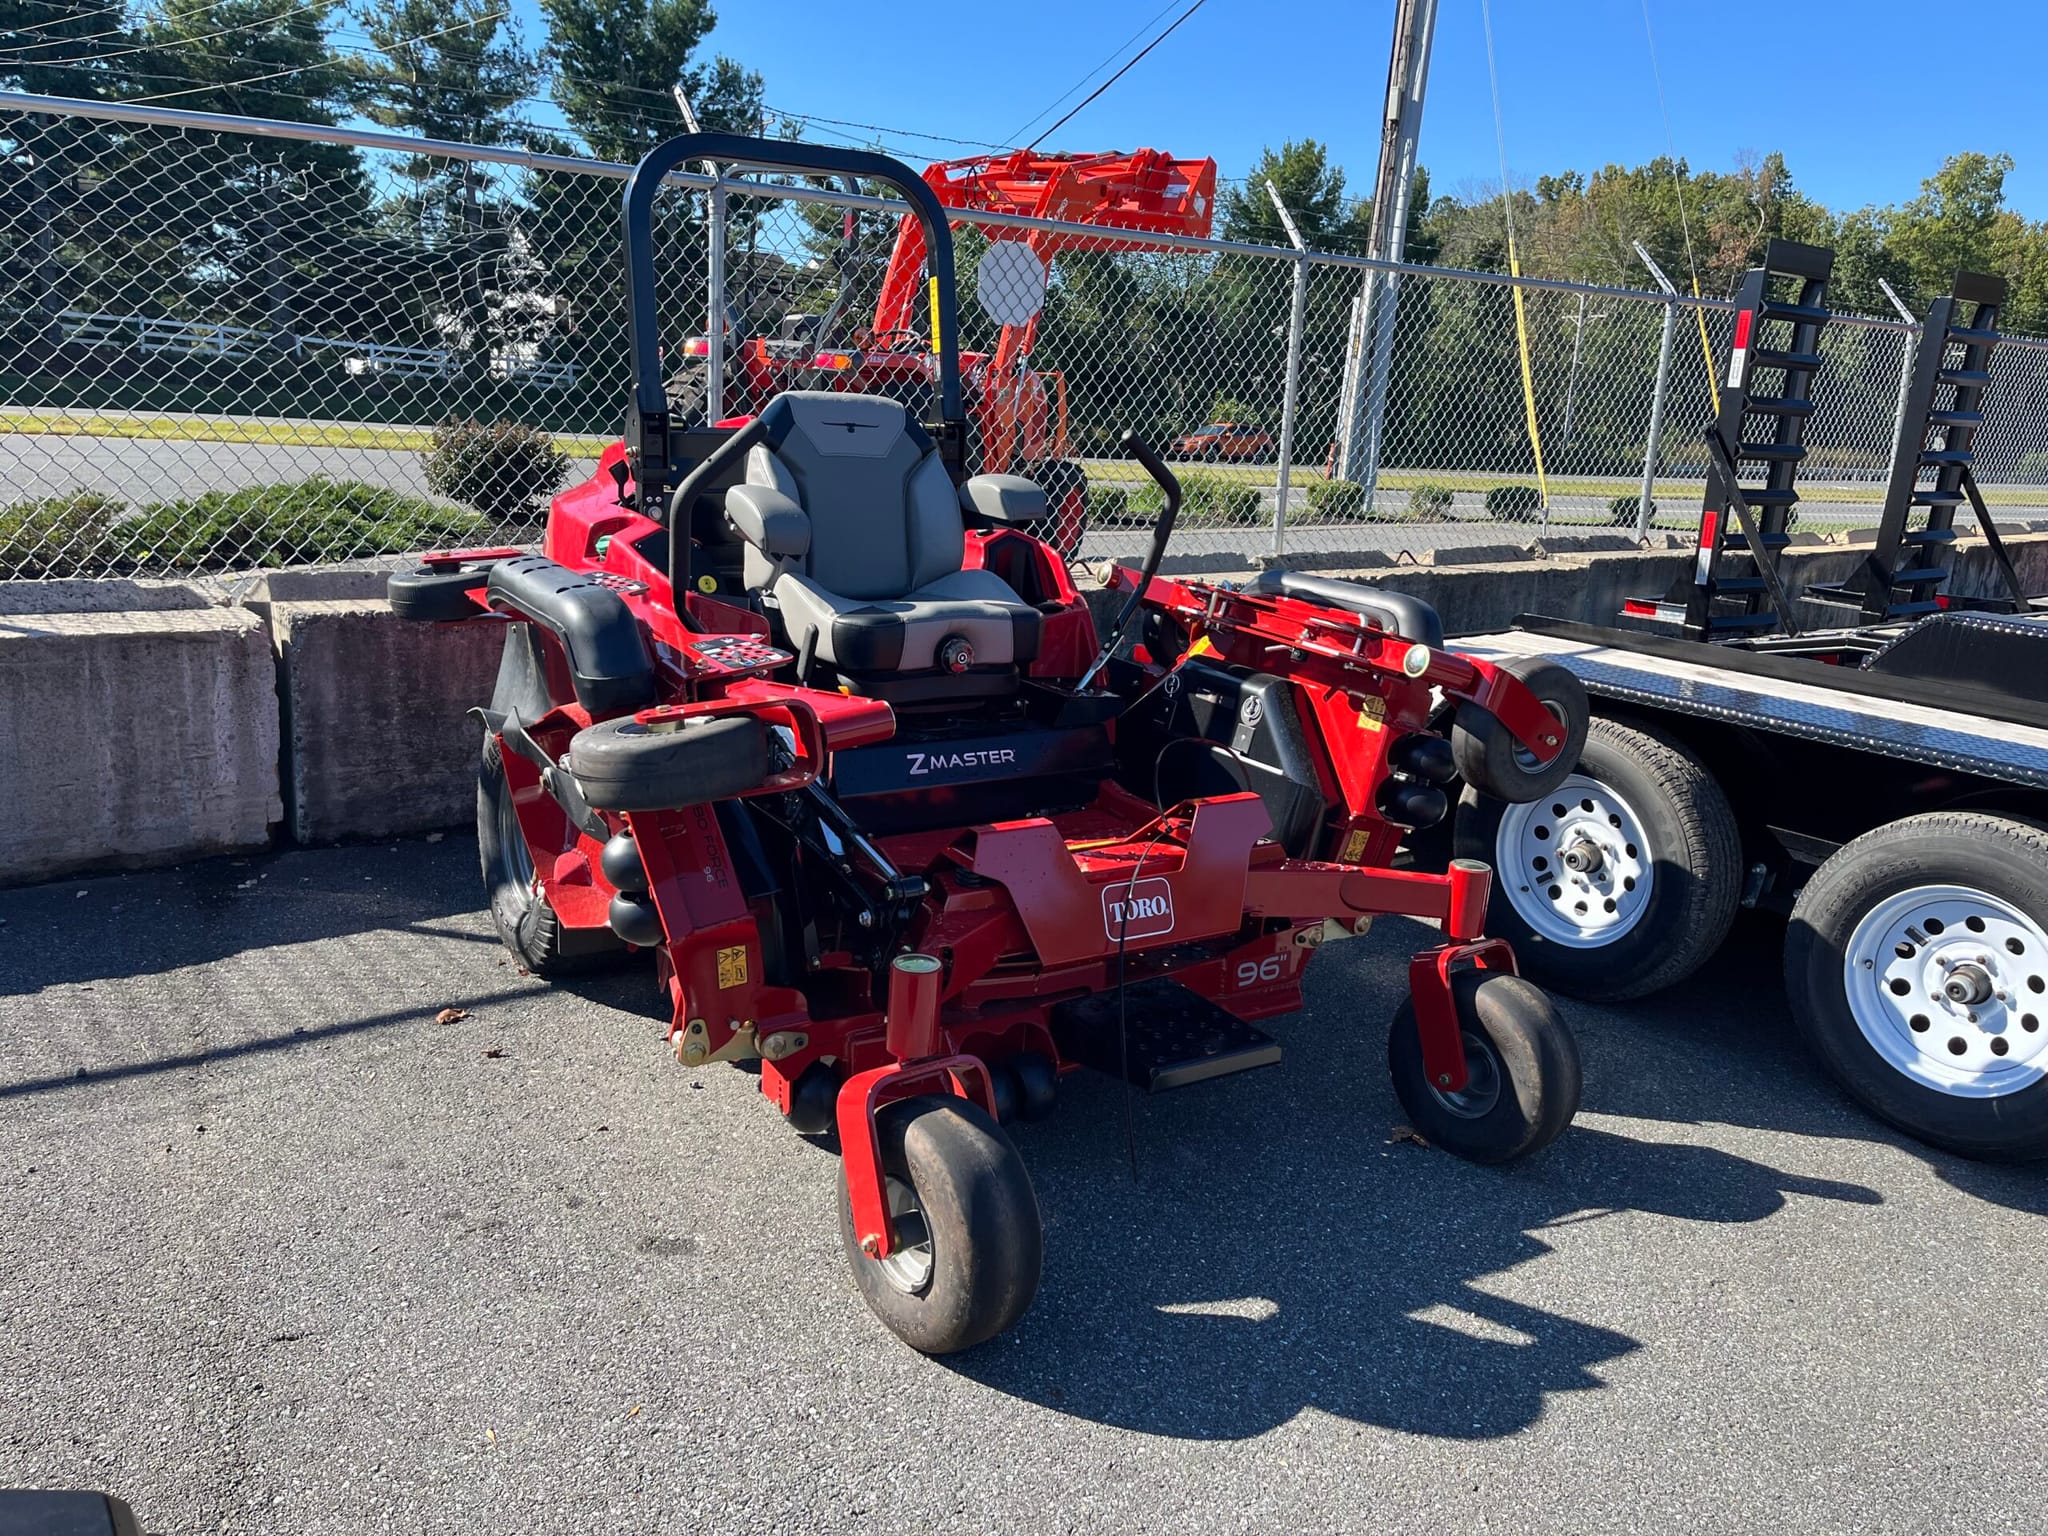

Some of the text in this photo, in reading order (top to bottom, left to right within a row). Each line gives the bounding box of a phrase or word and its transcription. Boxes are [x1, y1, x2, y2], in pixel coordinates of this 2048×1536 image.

[930, 748, 1016, 770] MASTER
[703, 865, 715, 883] 96
[704, 834, 729, 889] FORCE
[1109, 895, 1167, 923] TORO
